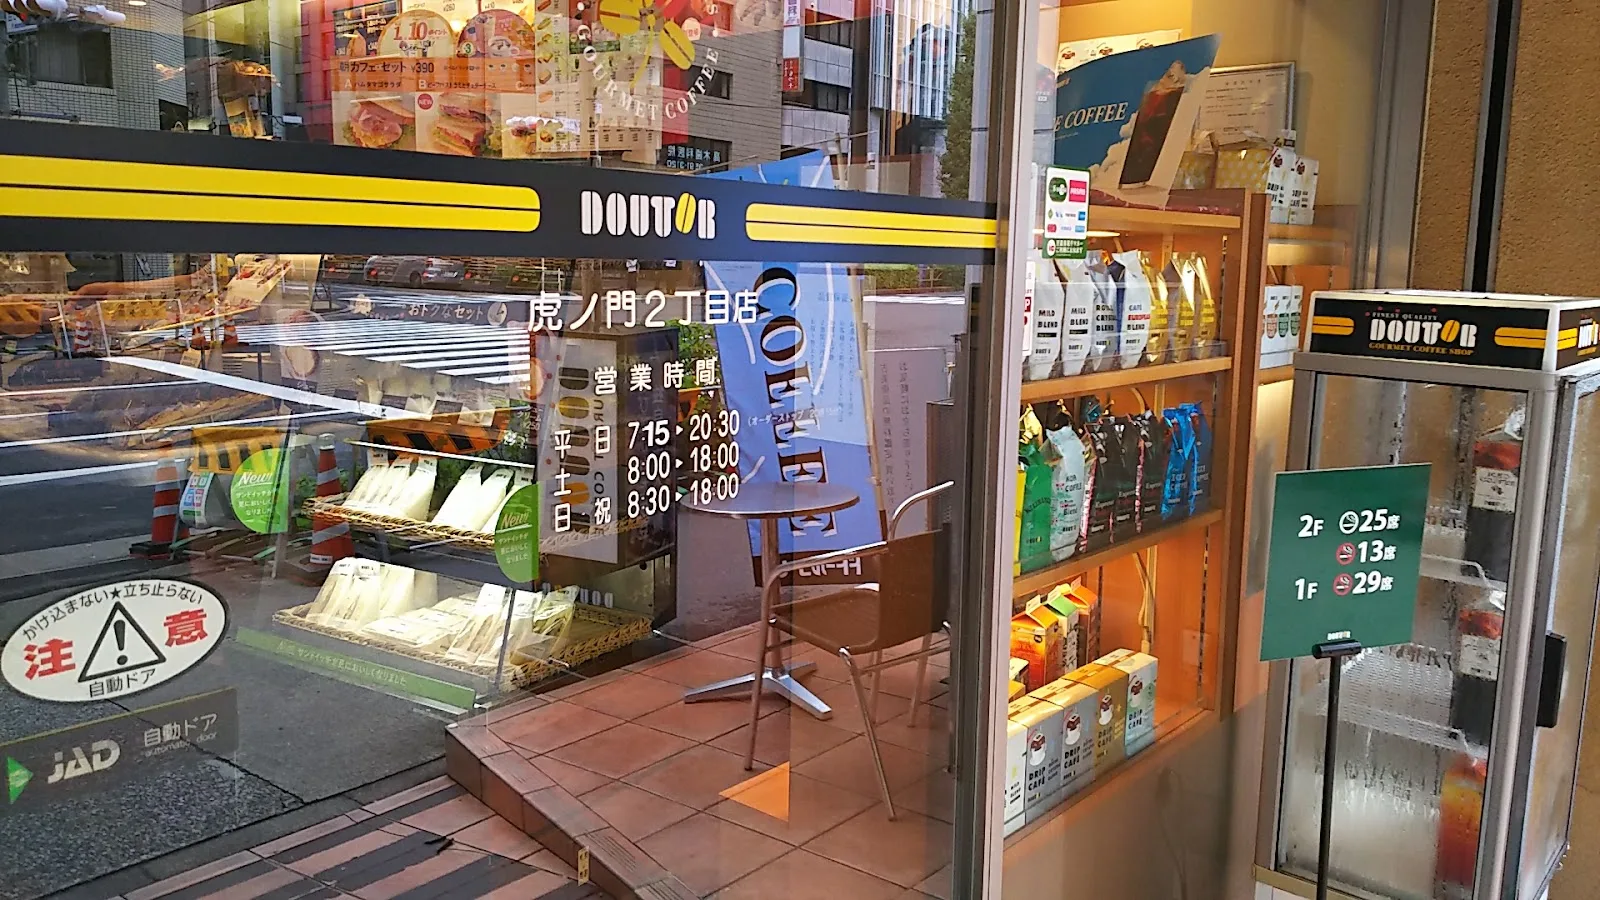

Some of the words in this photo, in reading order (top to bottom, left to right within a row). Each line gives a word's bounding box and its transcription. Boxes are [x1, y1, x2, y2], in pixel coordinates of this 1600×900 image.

[577, 25, 659, 121] GOURMET
[665, 47, 719, 119] COFFEE
[1064, 102, 1128, 129] COFFEE
[581, 190, 716, 240] DOUTOR
[408, 303, 484, 322] おトクなセット
[528, 289, 758, 332] 虎ノ門2丁目店
[1372, 311, 1399, 319] FINEST
[1368, 342, 1411, 351] GOURMET
[1412, 345, 1447, 354] COFFEE
[1370, 318, 1478, 348] DOUTOR
[594, 357, 721, 395] 営業時間
[627, 420, 670, 449] 7:15
[689, 409, 740, 441] 20:30
[553, 468, 572, 497] 土
[627, 451, 671, 485] 8:00
[689, 441, 740, 473] 18:00
[627, 485, 671, 518] 8:30
[689, 473, 740, 506] 18:00
[1298, 514, 1324, 537] 2F
[1358, 508, 1400, 532] 25席
[1357, 540, 1396, 563] 13席
[1295, 578, 1318, 600] 1F
[1352, 570, 1393, 595] 29席
[24, 638, 76, 680] 注
[163, 608, 208, 647] 意
[89, 668, 156, 698] 自動ドア
[143, 713, 218, 747] 自動ドア
[1064, 746, 1081, 759] DRIP
[1029, 766, 1046, 780] DRIP
